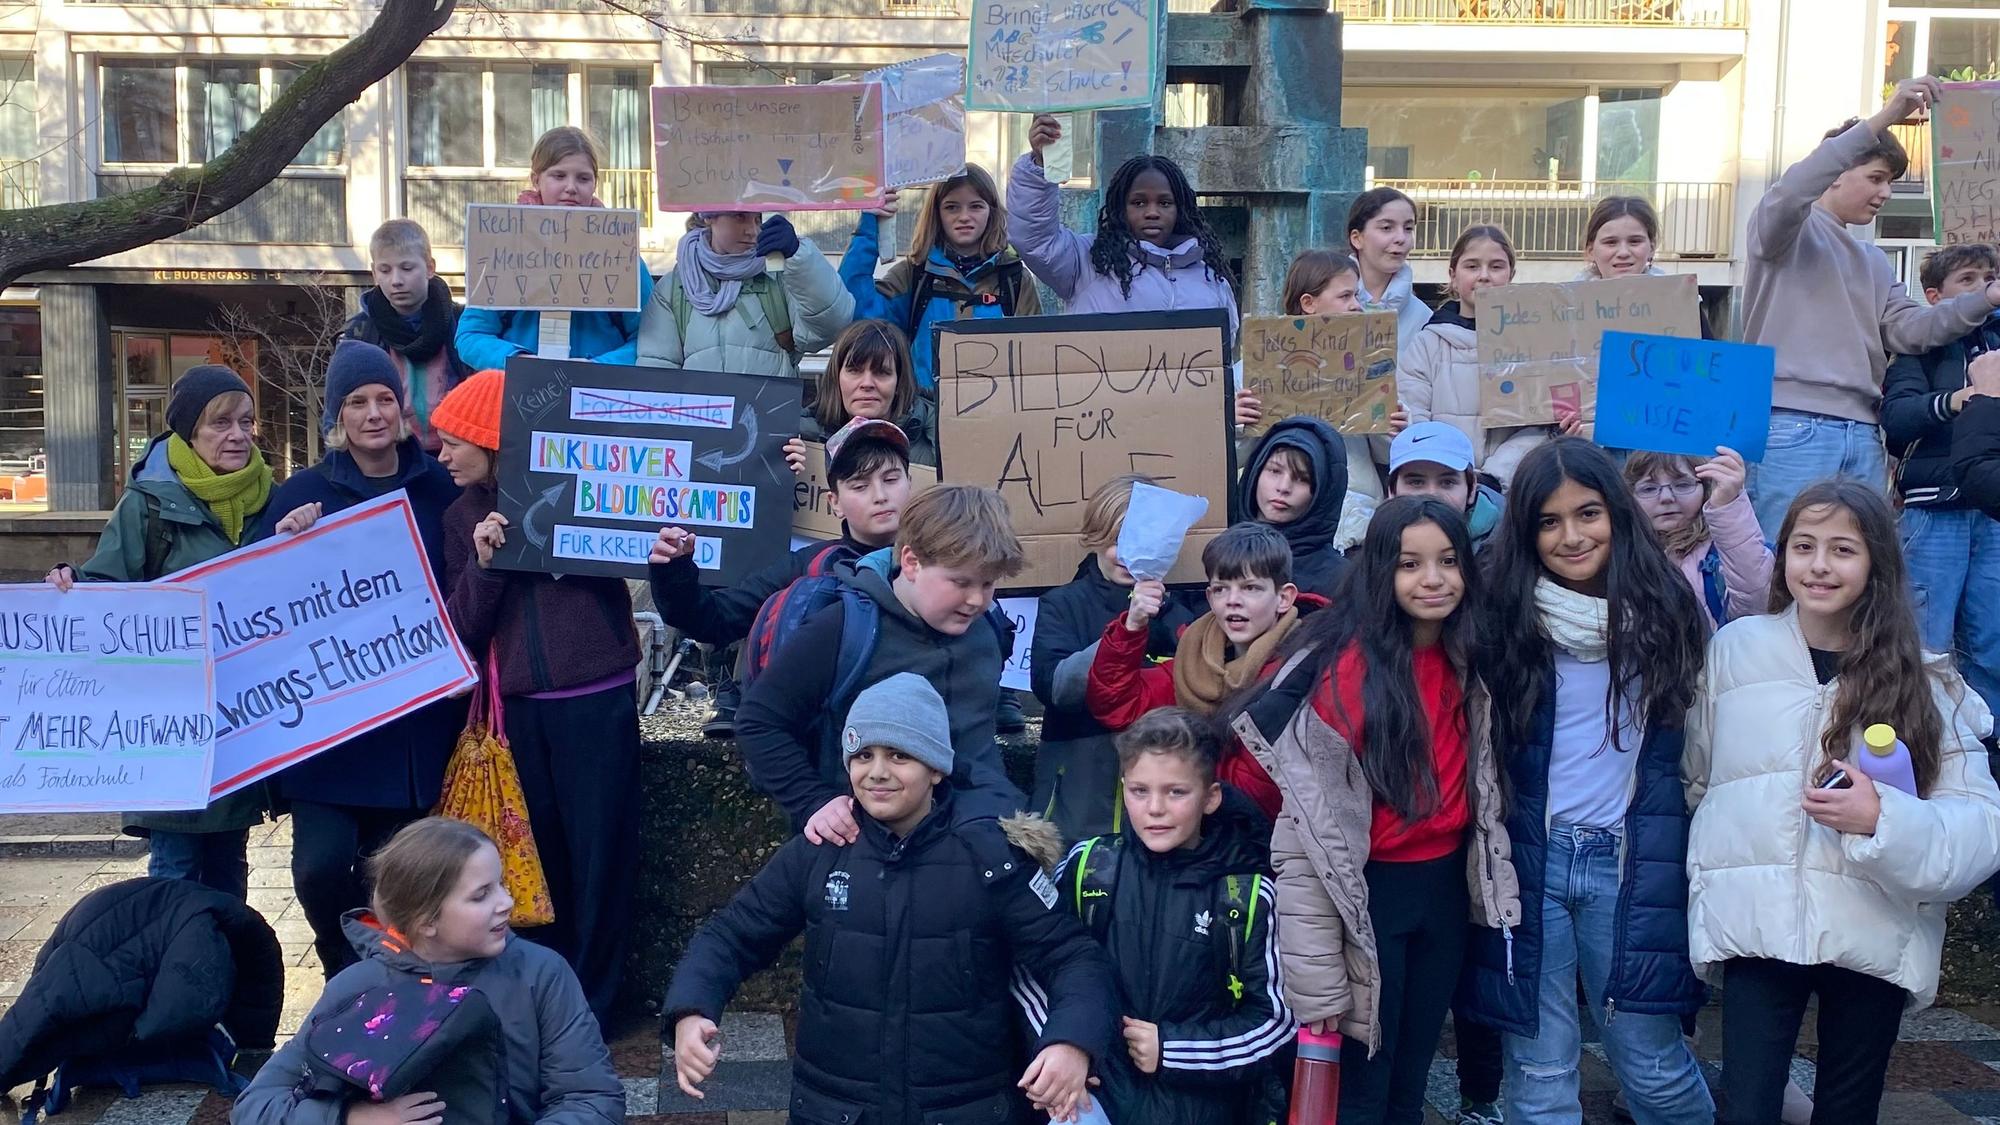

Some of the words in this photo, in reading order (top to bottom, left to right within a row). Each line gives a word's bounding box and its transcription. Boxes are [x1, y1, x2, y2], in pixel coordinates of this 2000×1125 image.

[984, 3, 1050, 33] Bringt
[677, 155, 760, 188] Schule
[479, 208, 524, 234] Recht
[539, 211, 573, 244] auf
[1311, 322, 1349, 350] Kind
[1364, 319, 1394, 349] hat
[1490, 303, 1541, 336] Jedes
[954, 339, 1214, 417] BILDUNG
[1053, 407, 1116, 448] FÜR
[538, 435, 684, 478] INKLUSIVER
[580, 480, 751, 524] BILDUNGSCAMPUS
[559, 530, 593, 555] FÜR
[288, 581, 337, 627] mit
[336, 569, 402, 609] dem
[0, 612, 89, 653] USIVE
[100, 612, 207, 656] SCHULE
[18, 668, 45, 705] für
[46, 669, 105, 699] Eltern
[15, 711, 100, 751] MEHR
[101, 709, 214, 751] AUFWAND
